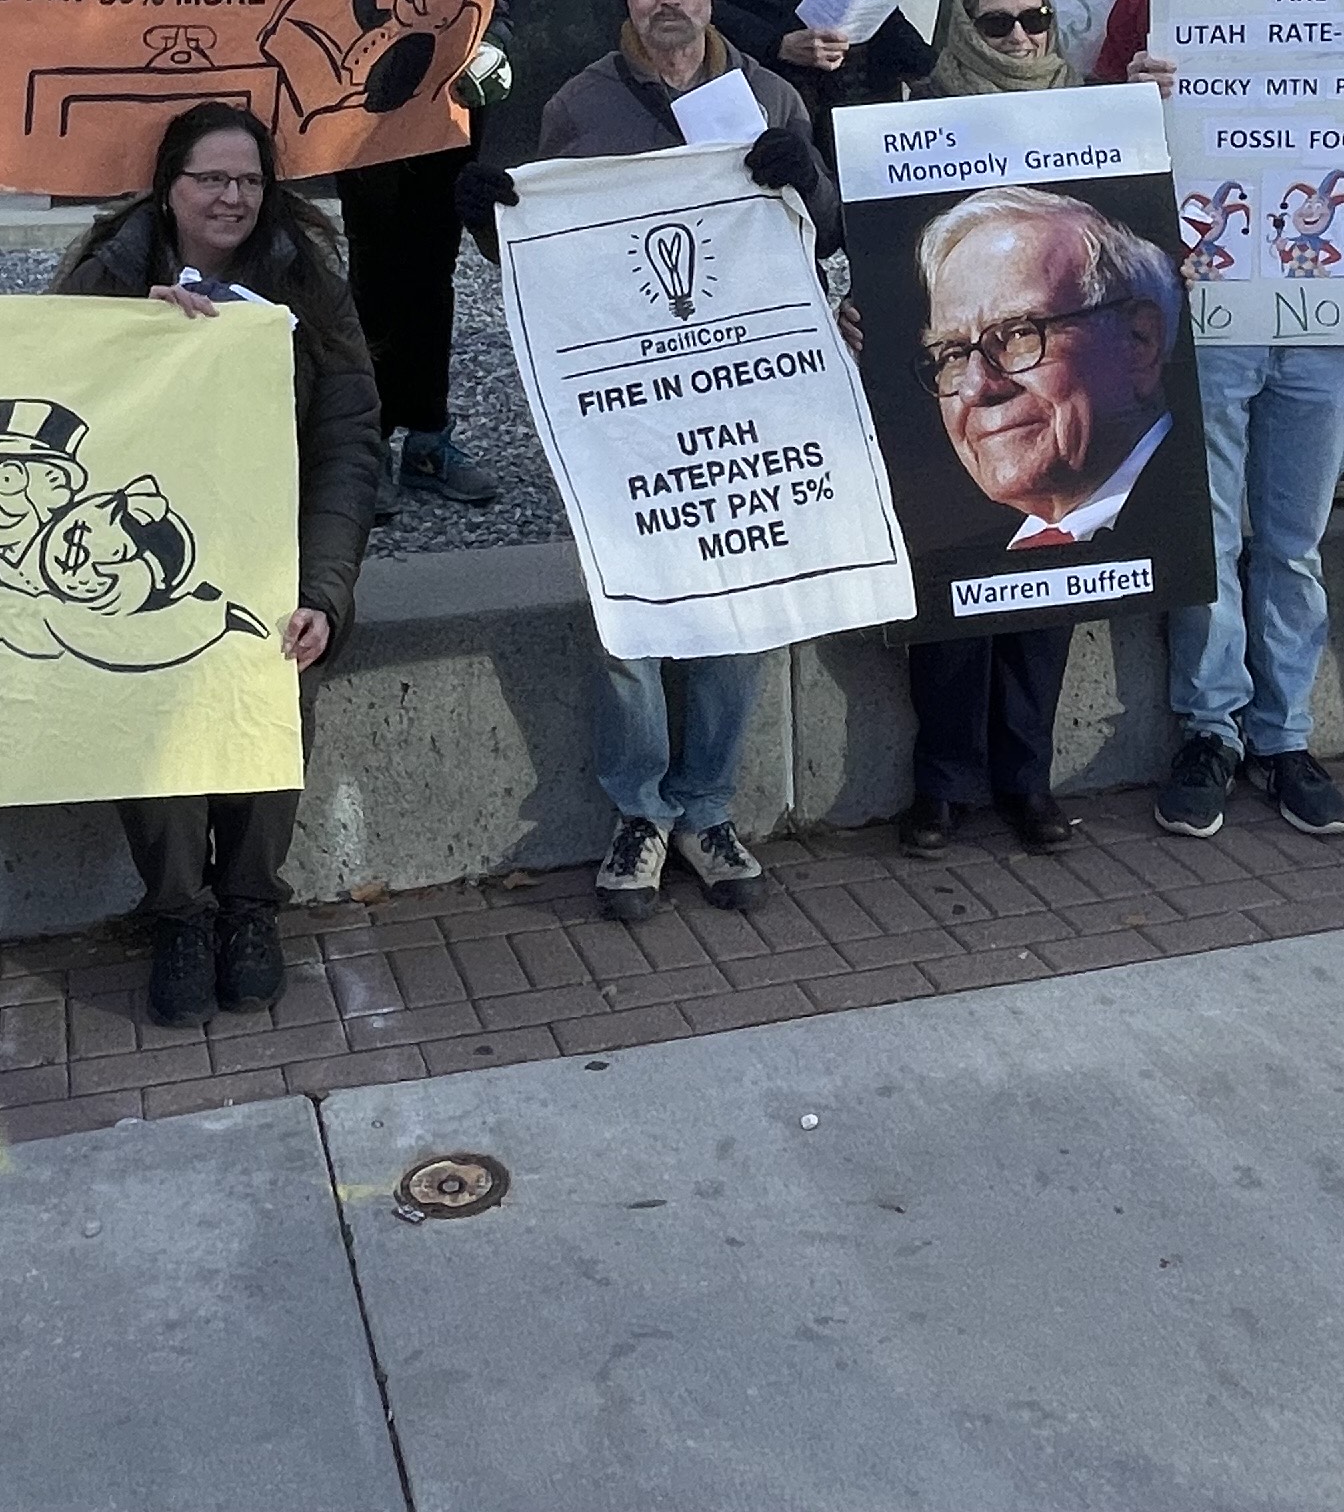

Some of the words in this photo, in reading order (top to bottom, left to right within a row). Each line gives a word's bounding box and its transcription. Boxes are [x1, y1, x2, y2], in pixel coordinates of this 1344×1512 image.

[1175, 24, 1246, 46] UTAH
[1178, 78, 1252, 97] ROCKY
[1266, 78, 1318, 96] MTN
[883, 129, 957, 154] RMP's
[1216, 129, 1296, 150] FOSSIL
[887, 153, 1008, 185] Monopoly
[1024, 145, 1123, 173] Grandpa
[640, 323, 748, 358] PacifiCorp
[577, 381, 647, 418] FIRE
[654, 374, 684, 403] IN
[690, 349, 827, 395] OREGON!
[676, 419, 759, 457] UTAH
[628, 441, 825, 501] RATEPAYERS
[635, 500, 716, 536] MUST
[729, 485, 782, 520] PAY
[697, 520, 790, 562] MORE
[955, 578, 1051, 608] Warren
[1066, 566, 1152, 596] Buffett
